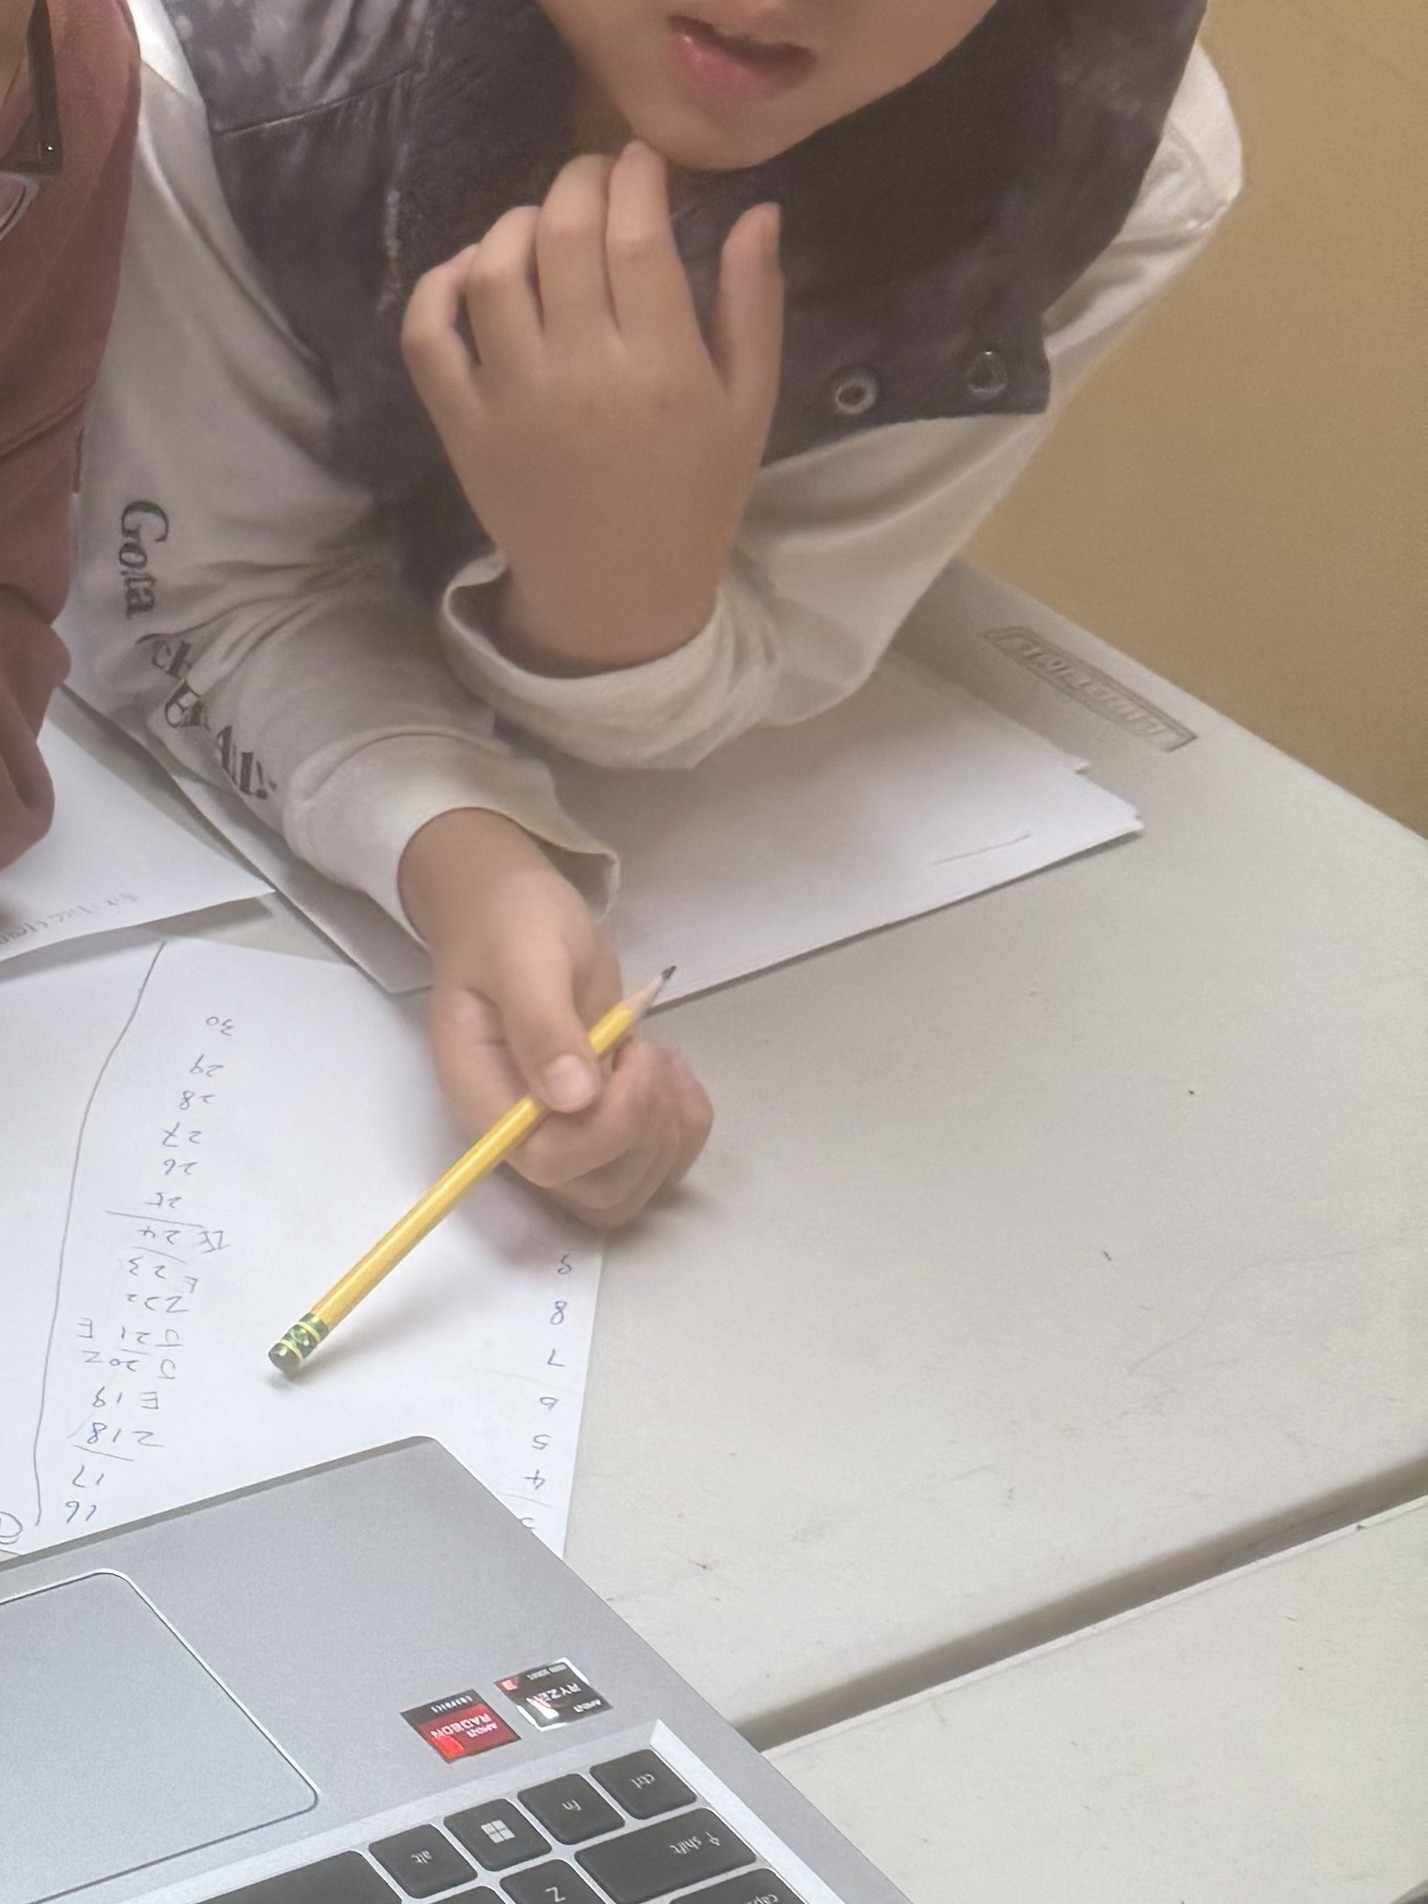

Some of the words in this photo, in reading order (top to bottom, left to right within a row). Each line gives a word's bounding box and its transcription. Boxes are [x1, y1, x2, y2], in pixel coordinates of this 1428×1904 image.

[205, 1015, 234, 1037] 30
[189, 1053, 224, 1078] 29
[178, 1090, 215, 1111] 28
[161, 1122, 203, 1148] 27
[163, 1158, 198, 1176] 26
[147, 1191, 182, 1209] 25
[138, 1225, 181, 1245] 24
[128, 1256, 166, 1280] 23
[550, 1300, 568, 1326] 8
[120, 1325, 151, 1345] 21
[108, 1358, 139, 1372] 20
[546, 1348, 565, 1368] 7
[91, 1385, 123, 1408] 19
[86, 1422, 122, 1445] 18
[531, 1433, 551, 1451] 5
[71, 1464, 105, 1489] 17
[524, 1469, 546, 1491] 4
[65, 1500, 97, 1524] 16
[630, 1773, 655, 1790] ctrl
[562, 1799, 582, 1811] fn
[669, 1835, 702, 1854] shift
[411, 1850, 432, 1864] alt
[545, 1886, 566, 1903] Z
